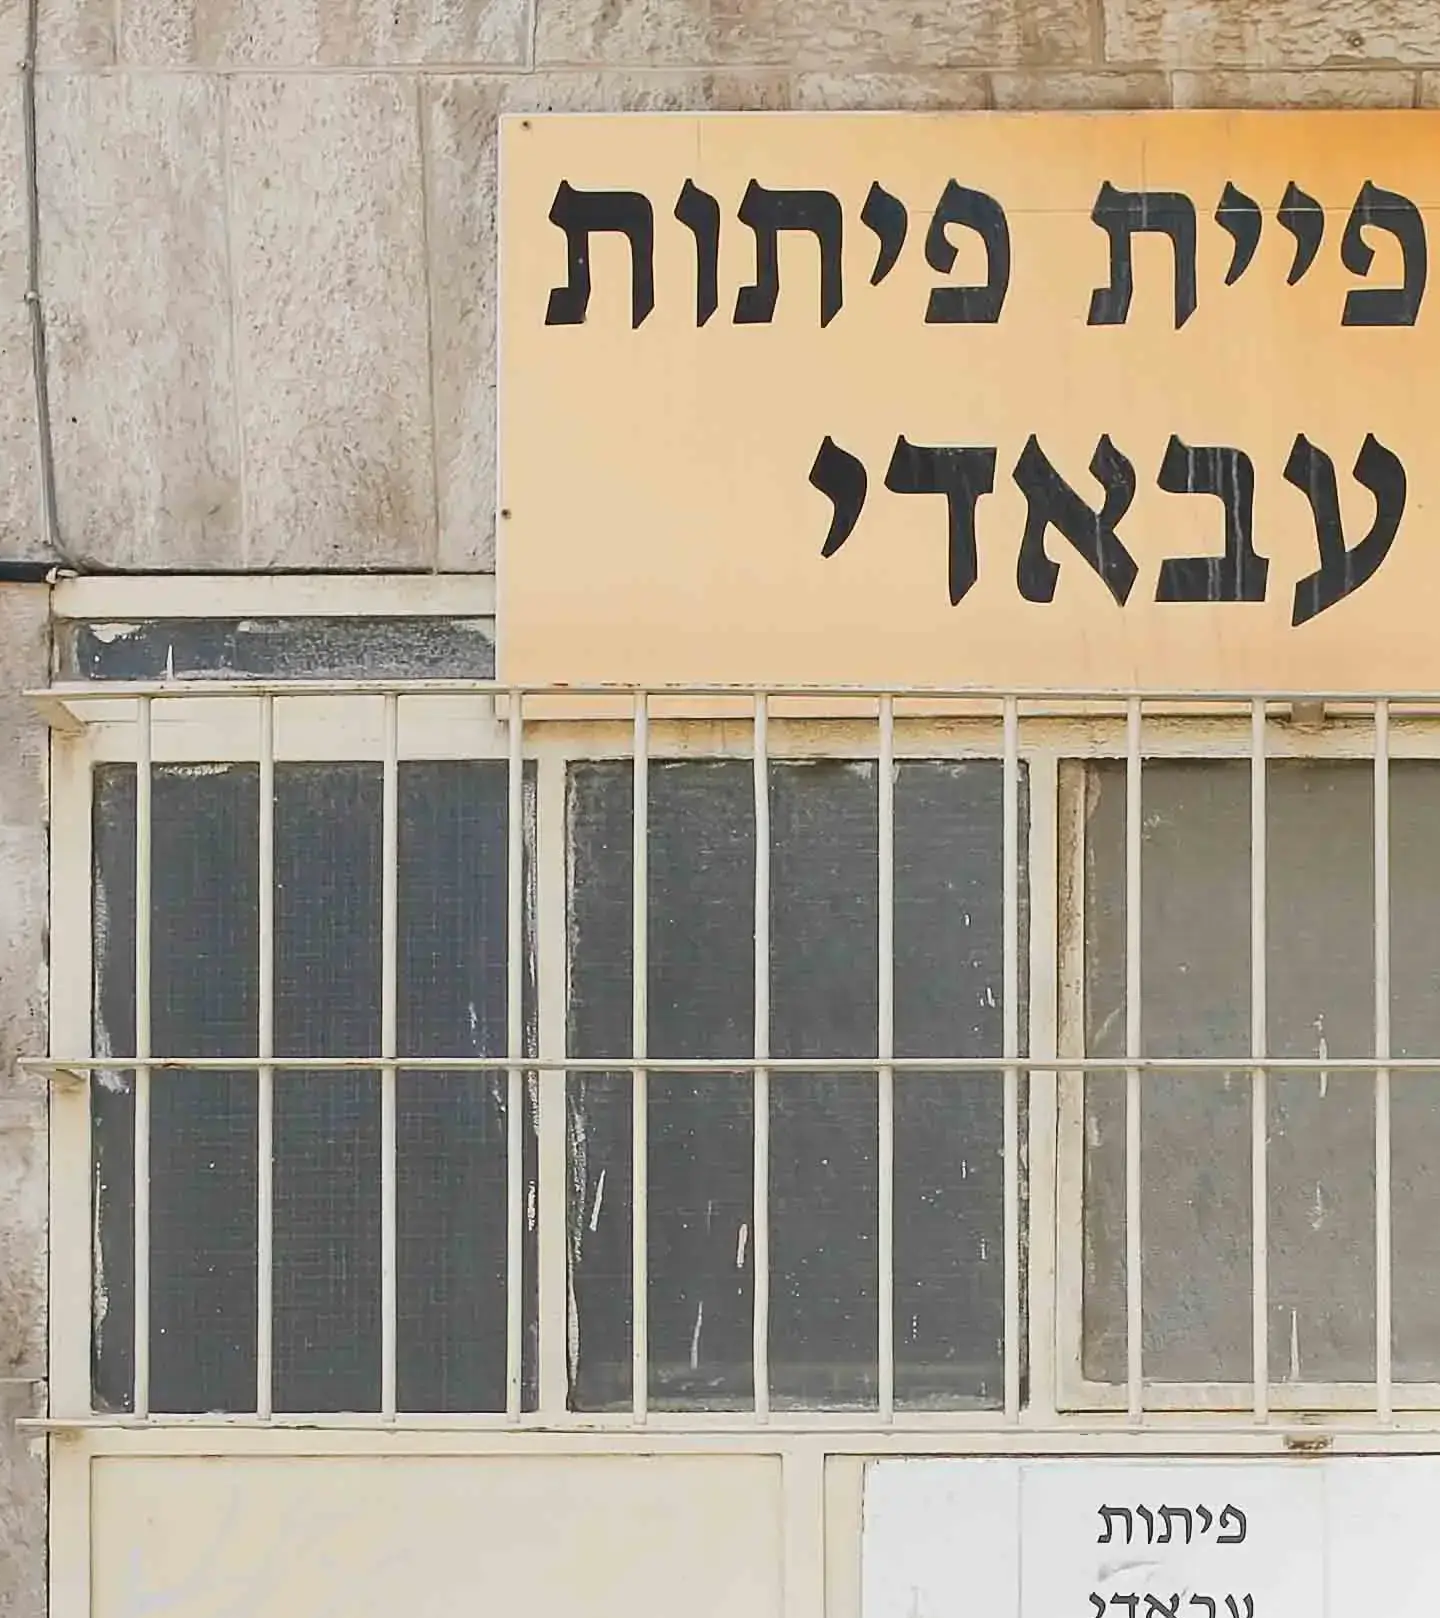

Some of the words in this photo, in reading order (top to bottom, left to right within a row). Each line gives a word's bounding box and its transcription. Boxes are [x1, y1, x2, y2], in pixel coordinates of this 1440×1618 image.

[544, 178, 1011, 330] פיתות
[808, 432, 1407, 627] עבאדי
[1096, 1503, 1247, 1545] פיתות
